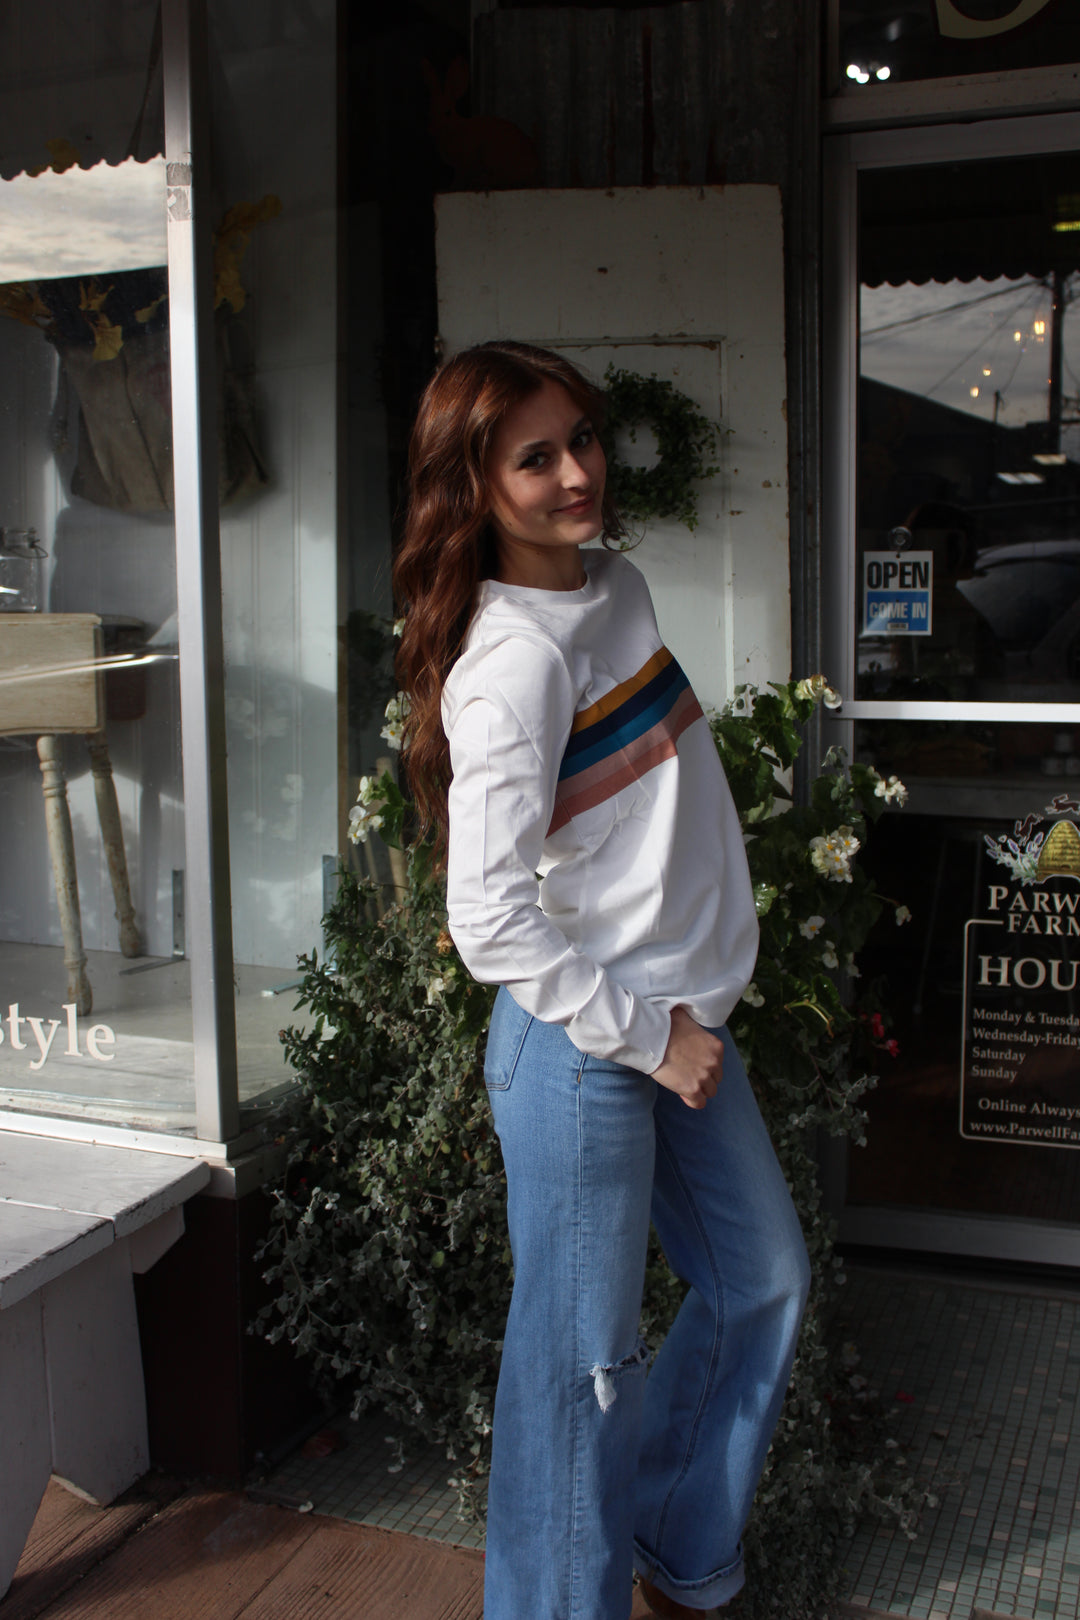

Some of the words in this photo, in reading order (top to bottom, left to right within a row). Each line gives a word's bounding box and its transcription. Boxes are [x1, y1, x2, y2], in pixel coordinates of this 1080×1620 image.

[867, 561, 929, 590] OPEN
[869, 602, 908, 619] COME
[912, 602, 926, 619] IN
[988, 885, 1080, 914] PARW
[978, 955, 1080, 991] HOU
[972, 1007, 1022, 1026] Monday
[1025, 1011, 1036, 1024] &
[0, 1003, 116, 1071] tyle
[972, 1046, 1026, 1065] Saturday
[971, 1064, 1018, 1083] Sunday
[978, 1097, 1027, 1114] Online
